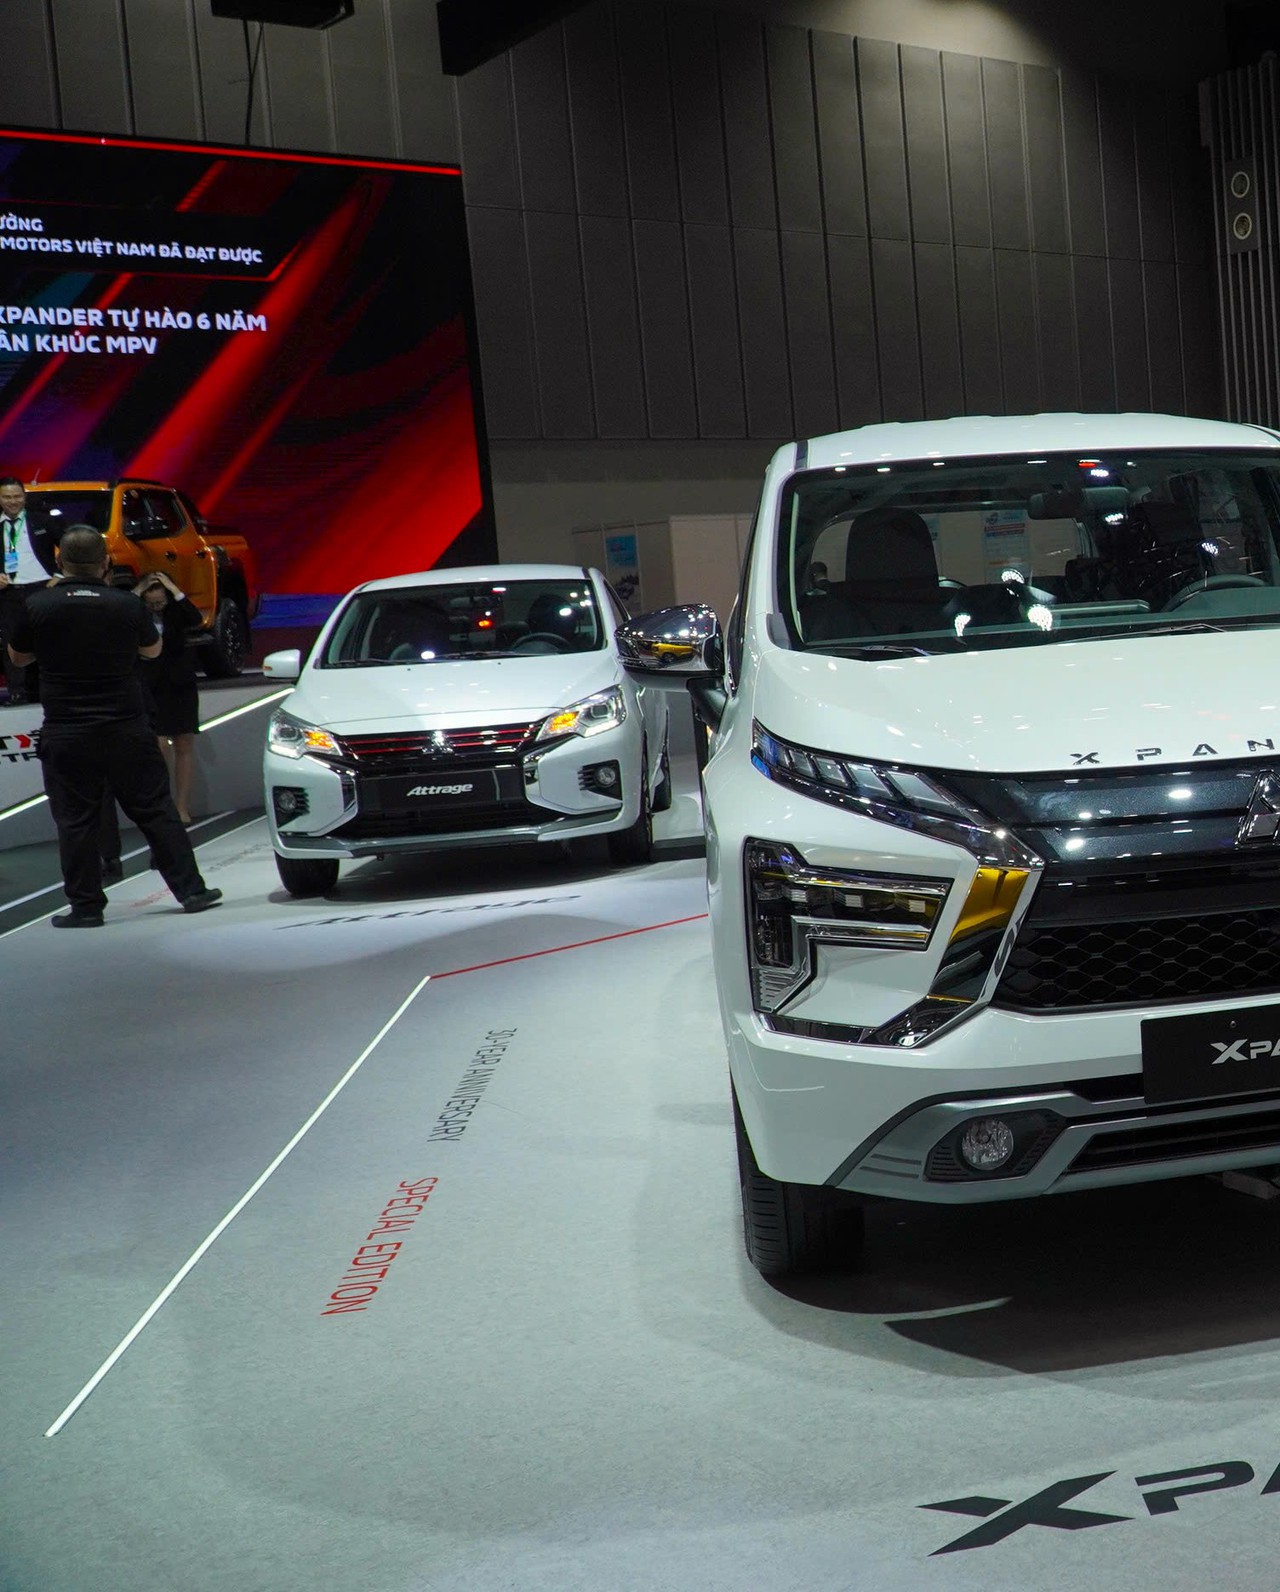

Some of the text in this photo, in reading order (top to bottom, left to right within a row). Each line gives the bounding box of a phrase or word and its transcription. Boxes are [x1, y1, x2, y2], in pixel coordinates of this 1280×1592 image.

[0, 236, 263, 265] MOTORS VIỆT NAM ĐÃ ĐẠT ĐƯỢC
[107, 308, 140, 332] TỰ
[145, 306, 193, 330] HÀO
[196, 314, 212, 330] 6
[215, 309, 267, 332] NĂM
[35, 331, 101, 353] KHÚC
[106, 335, 157, 355] MPV
[406, 783, 473, 797] Attrage
[426, 1067, 496, 1142] ANNIVERSARY
[319, 1176, 439, 1316] SPECIAL EDITION
